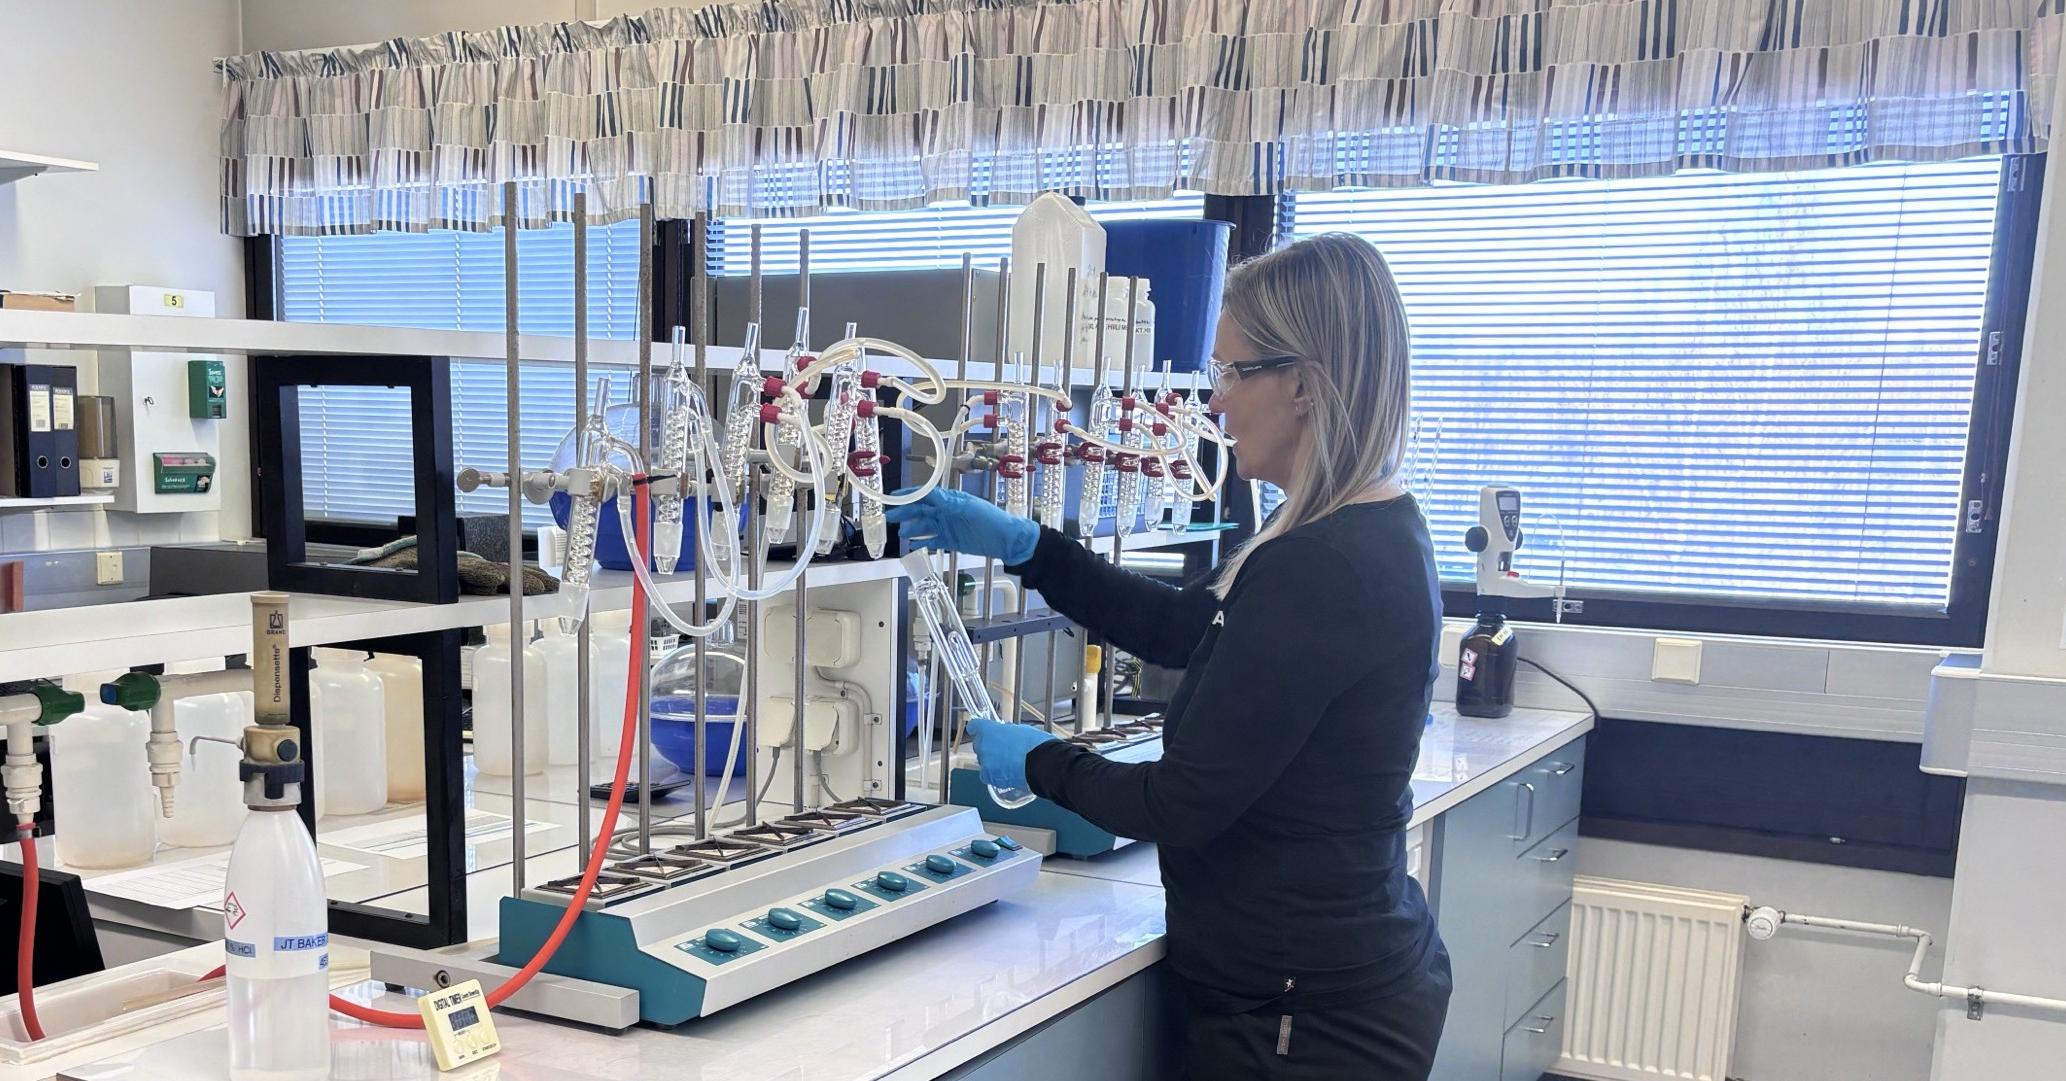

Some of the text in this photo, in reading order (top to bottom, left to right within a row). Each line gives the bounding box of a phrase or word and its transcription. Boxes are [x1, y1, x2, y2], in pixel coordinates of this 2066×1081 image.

[171, 295, 177, 306] 5
[280, 935, 326, 950] JT BAKER
